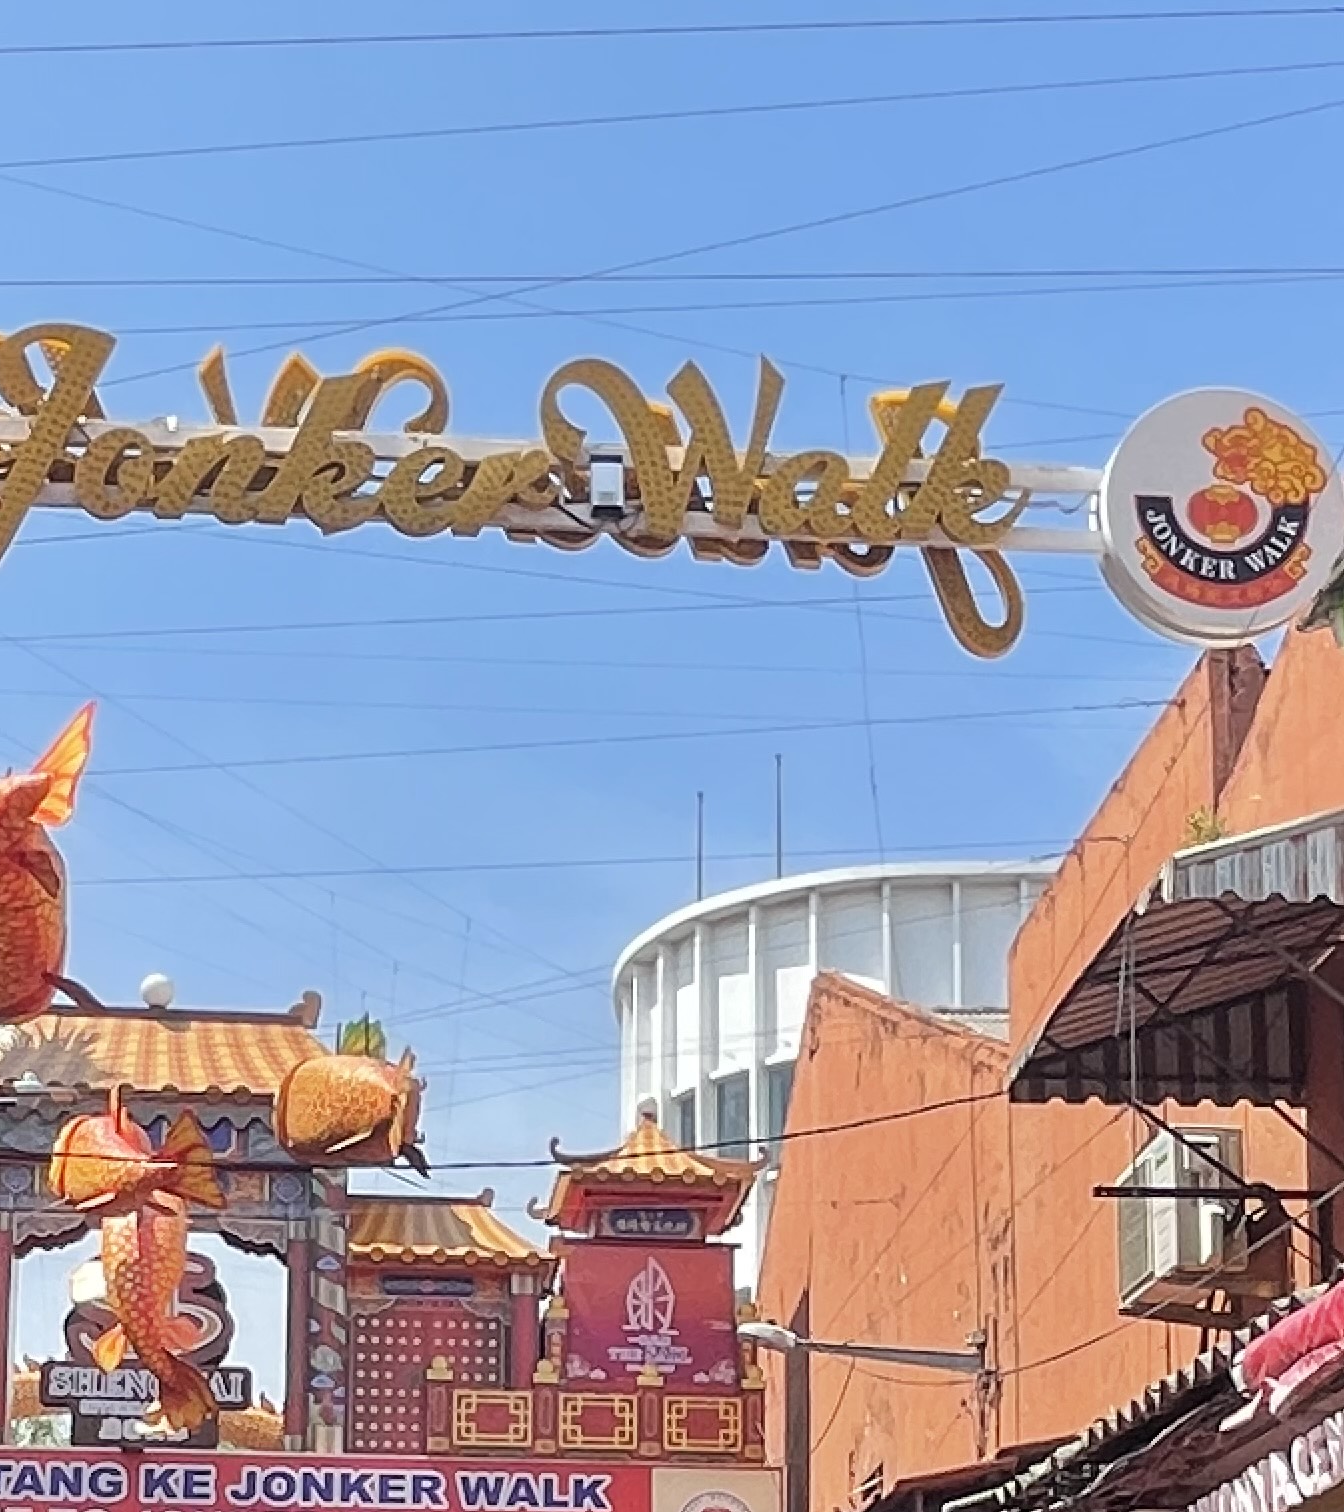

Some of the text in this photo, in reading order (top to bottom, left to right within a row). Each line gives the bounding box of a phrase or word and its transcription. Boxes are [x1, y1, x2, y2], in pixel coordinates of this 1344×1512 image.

[538, 355, 1030, 658] Walk
[1146, 508, 1301, 580] JONKER WALK
[141, 1466, 214, 1501] KE
[228, 1468, 446, 1506] JONKER
[457, 1473, 610, 1510] WALK
